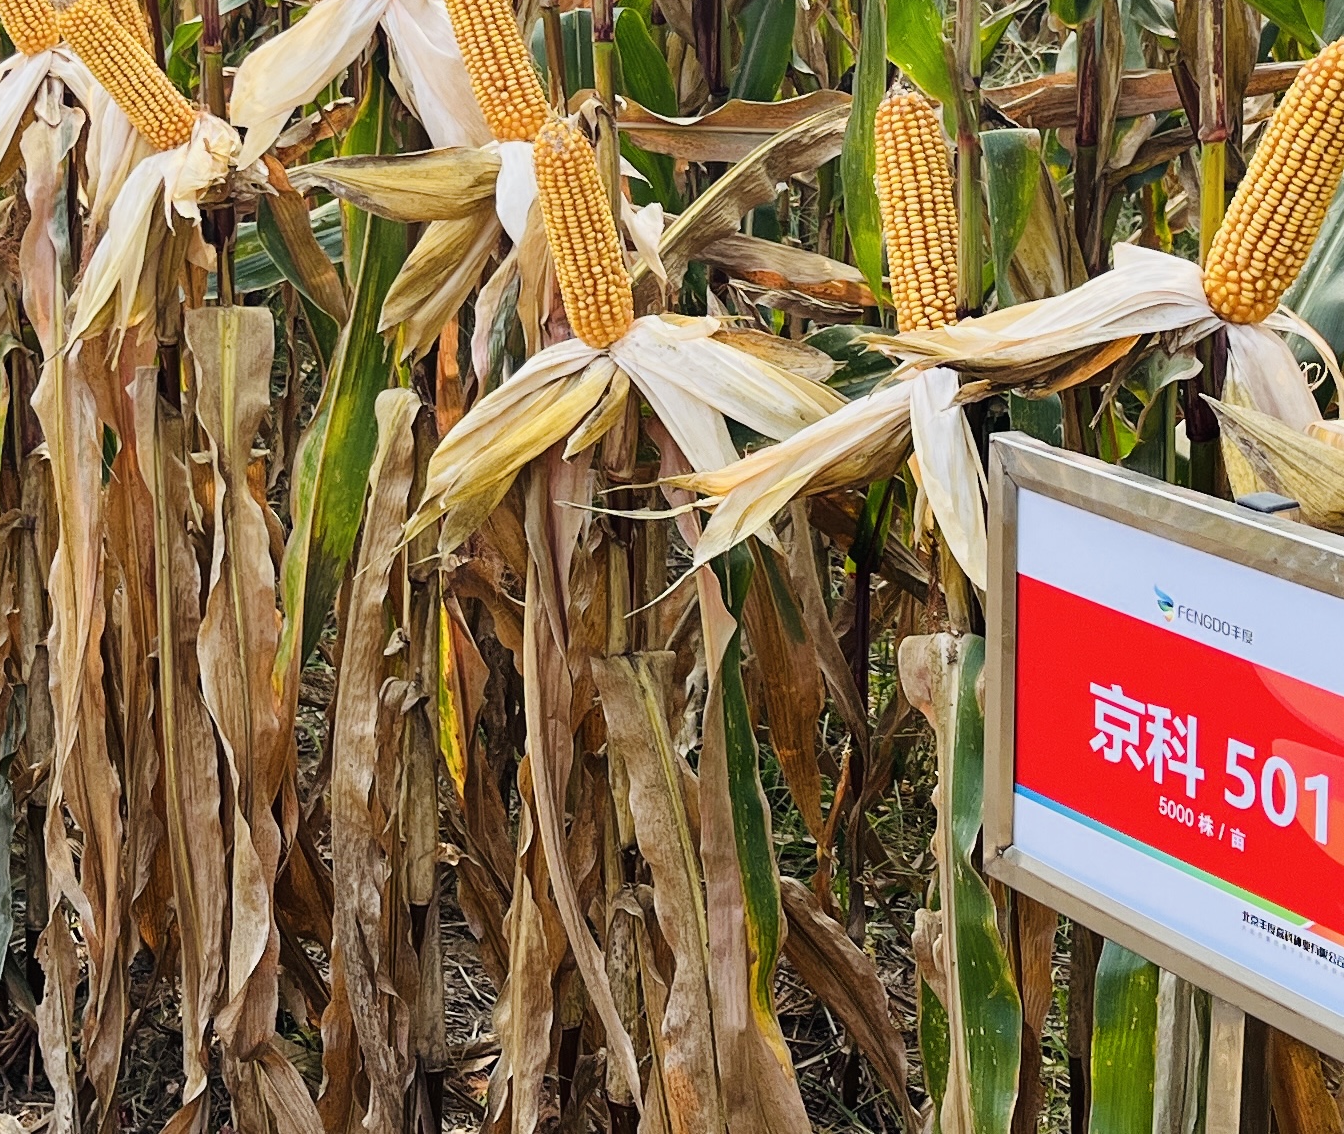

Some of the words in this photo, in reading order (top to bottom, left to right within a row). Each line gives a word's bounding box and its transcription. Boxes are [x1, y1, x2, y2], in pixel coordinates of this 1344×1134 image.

[1088, 681, 1205, 799] 京科
[1223, 737, 1329, 846] 501
[1158, 795, 1195, 828] 5000
